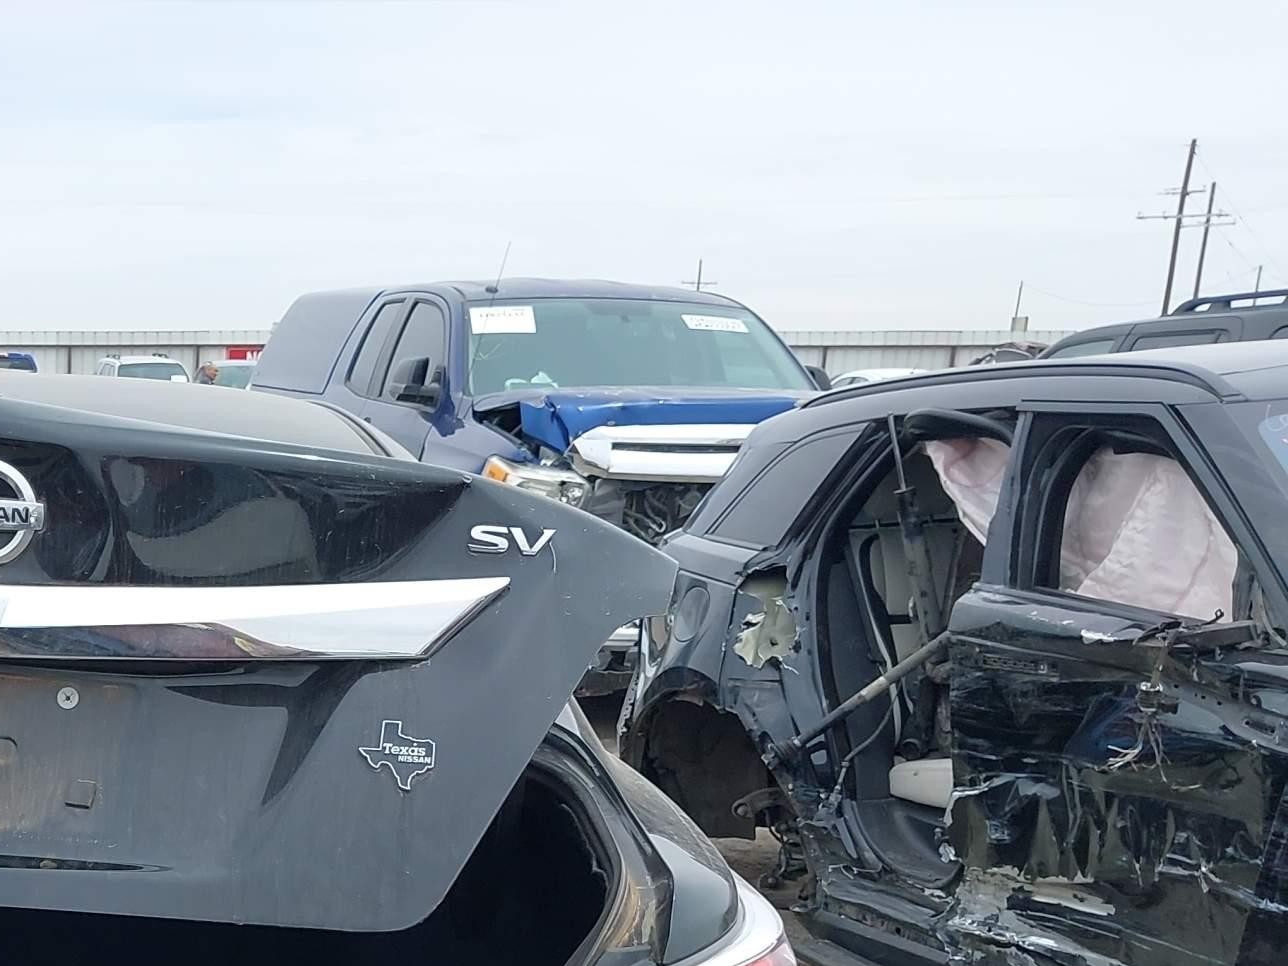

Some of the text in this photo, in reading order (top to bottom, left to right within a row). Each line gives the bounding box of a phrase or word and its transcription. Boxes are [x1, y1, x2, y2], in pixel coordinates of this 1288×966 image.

[467, 525, 557, 555] SV
[383, 743, 426, 756] Texas
[398, 755, 431, 763] NISSAN
